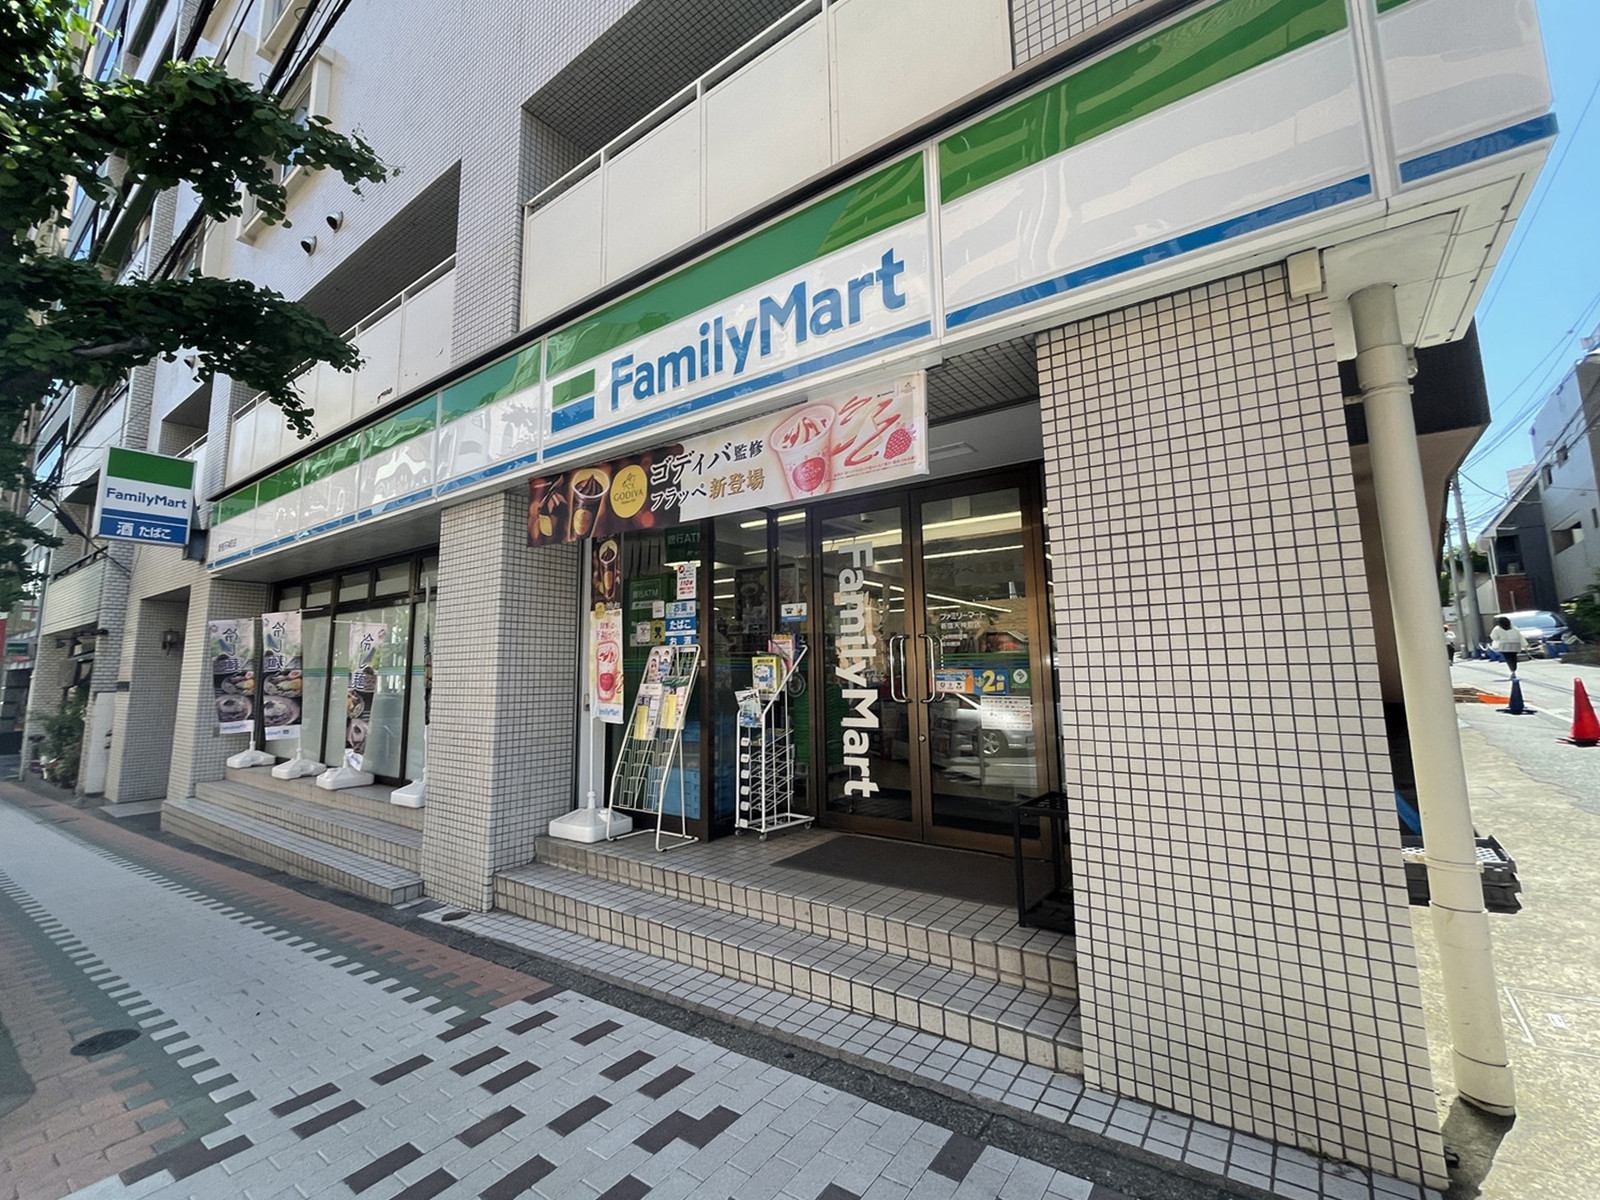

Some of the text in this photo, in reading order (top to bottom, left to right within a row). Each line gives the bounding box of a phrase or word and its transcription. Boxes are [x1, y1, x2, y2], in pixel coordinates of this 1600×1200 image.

[610, 247, 906, 412] FamilyMart
[651, 439, 764, 486] ゴディバ監修
[106, 487, 188, 509] FamilyMart
[613, 489, 645, 502] GODIVA
[651, 467, 766, 512] フラッペ新登場
[116, 521, 172, 540] 酒 たばこ
[669, 619, 692, 630] たばこ
[940, 611, 986, 621] ファミリーマート
[836, 541, 880, 798] FamilyMart
